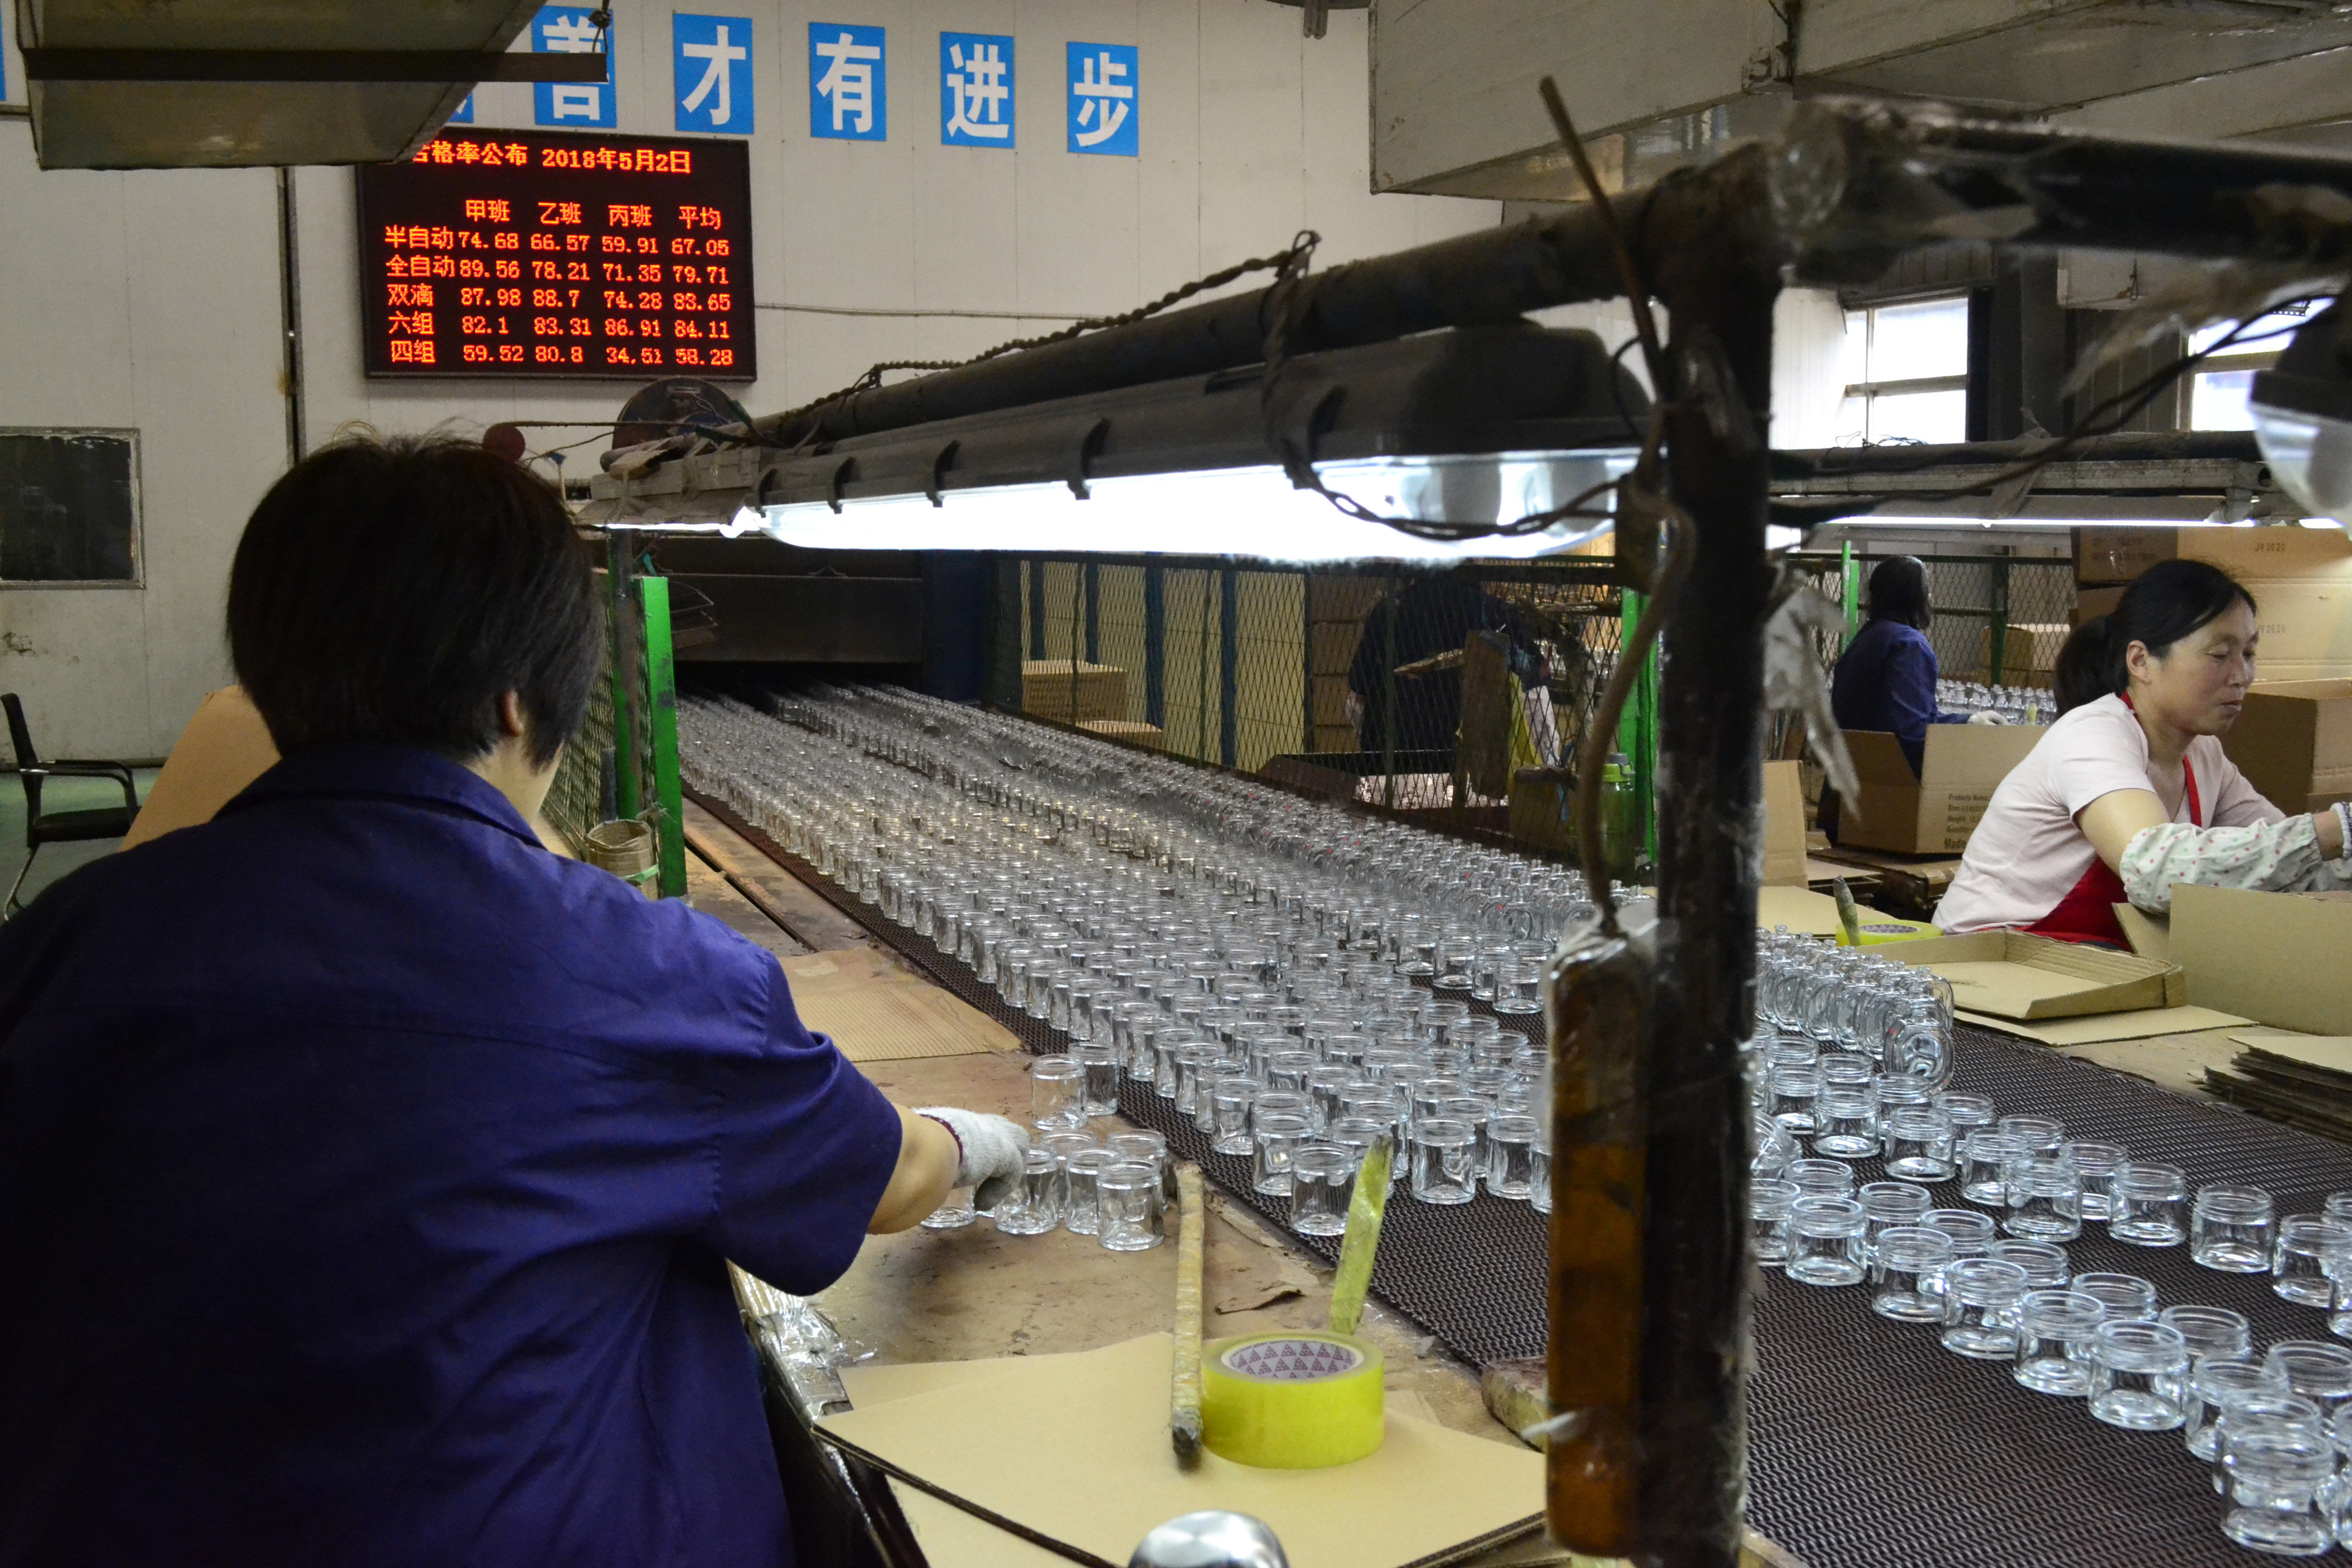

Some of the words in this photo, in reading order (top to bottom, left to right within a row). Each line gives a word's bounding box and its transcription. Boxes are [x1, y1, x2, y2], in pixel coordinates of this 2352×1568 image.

[457, 15, 1134, 147] 善才有进步
[542, 147, 692, 174] 2018年5月2日
[465, 199, 511, 223] 甲班
[537, 201, 582, 226] 乙班
[607, 204, 653, 228] 丙班
[678, 205, 722, 231] 平均
[384, 224, 454, 251] 半自动
[458, 231, 520, 250] 74.68
[530, 233, 591, 252] 66.57
[601, 236, 659, 254] 59.91
[671, 238, 730, 257] 67.05
[385, 254, 455, 278] 全自动
[459, 259, 521, 279] 89.56
[531, 260, 591, 281] 78.21
[602, 263, 662, 283] 71.35
[672, 265, 729, 285] 79.71
[386, 282, 434, 307] 双滴
[460, 287, 522, 307] 87.98
[532, 288, 580, 308] 88.7
[603, 290, 663, 311] 74.28
[673, 292, 731, 312] 83.65
[388, 311, 435, 335] 六组
[462, 315, 509, 335] 82.1
[534, 316, 593, 336] 83.31
[604, 318, 662, 337] 86.91
[674, 320, 730, 339] 84.11
[390, 339, 436, 364] 四组
[463, 344, 524, 362] 59.52
[535, 345, 584, 363] 80.8
[606, 346, 663, 365] 34.51
[1944, 838, 1967, 849] Made
